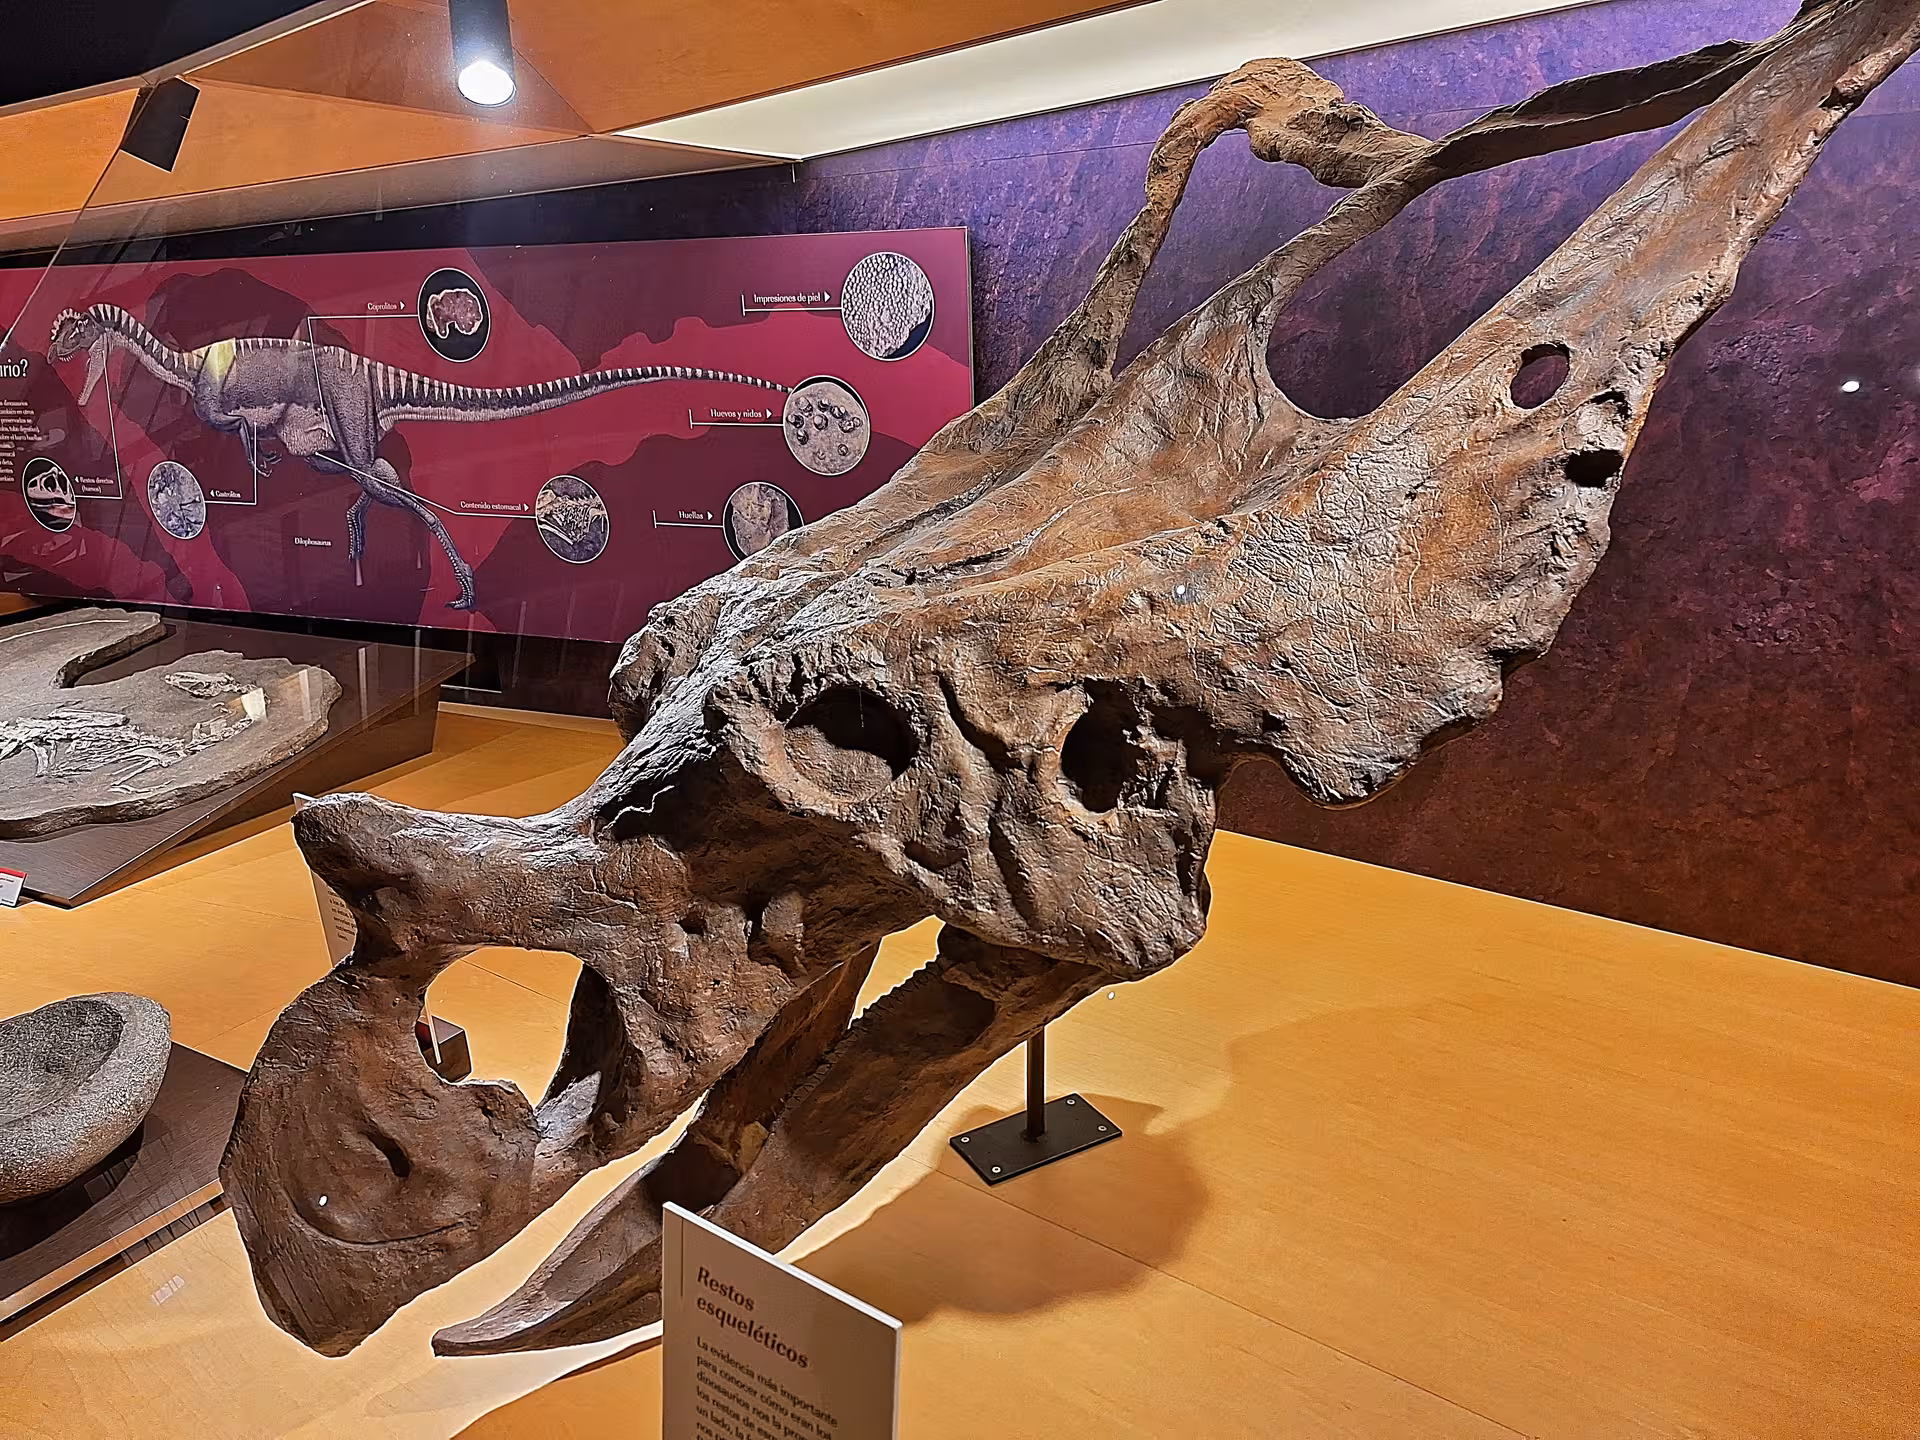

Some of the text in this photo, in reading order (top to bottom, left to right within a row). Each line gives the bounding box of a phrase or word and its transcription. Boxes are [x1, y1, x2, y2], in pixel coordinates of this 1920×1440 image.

[367, 302, 398, 312] Coprolitos
[753, 292, 821, 305] Impresiones de piel
[710, 409, 737, 418] Huevos
[743, 409, 763, 418] nidos
[460, 501, 491, 510] Contenido
[678, 511, 704, 520] Huellas
[294, 537, 332, 547] Dilophosaurus
[696, 1266, 755, 1312] Restos
[697, 1297, 809, 1369] esqueléticos
[696, 1355, 718, 1374] para
[719, 1369, 758, 1398] conocer
[759, 1393, 789, 1417] cómo
[790, 1412, 814, 1432] eran
[697, 1336, 839, 1429] La evidencia más importante
[696, 1371, 750, 1411] dinosaurios
[752, 1407, 770, 1423] nos
[772, 1415, 782, 1430] la
[696, 1385, 710, 1403] los
[712, 1399, 740, 1421] restos
[742, 1416, 756, 1431] de
[696, 1405, 709, 1418] un
[710, 1410, 732, 1435] lado,
[735, 1426, 745, 1440] la
[696, 1422, 713, 1438] nos
